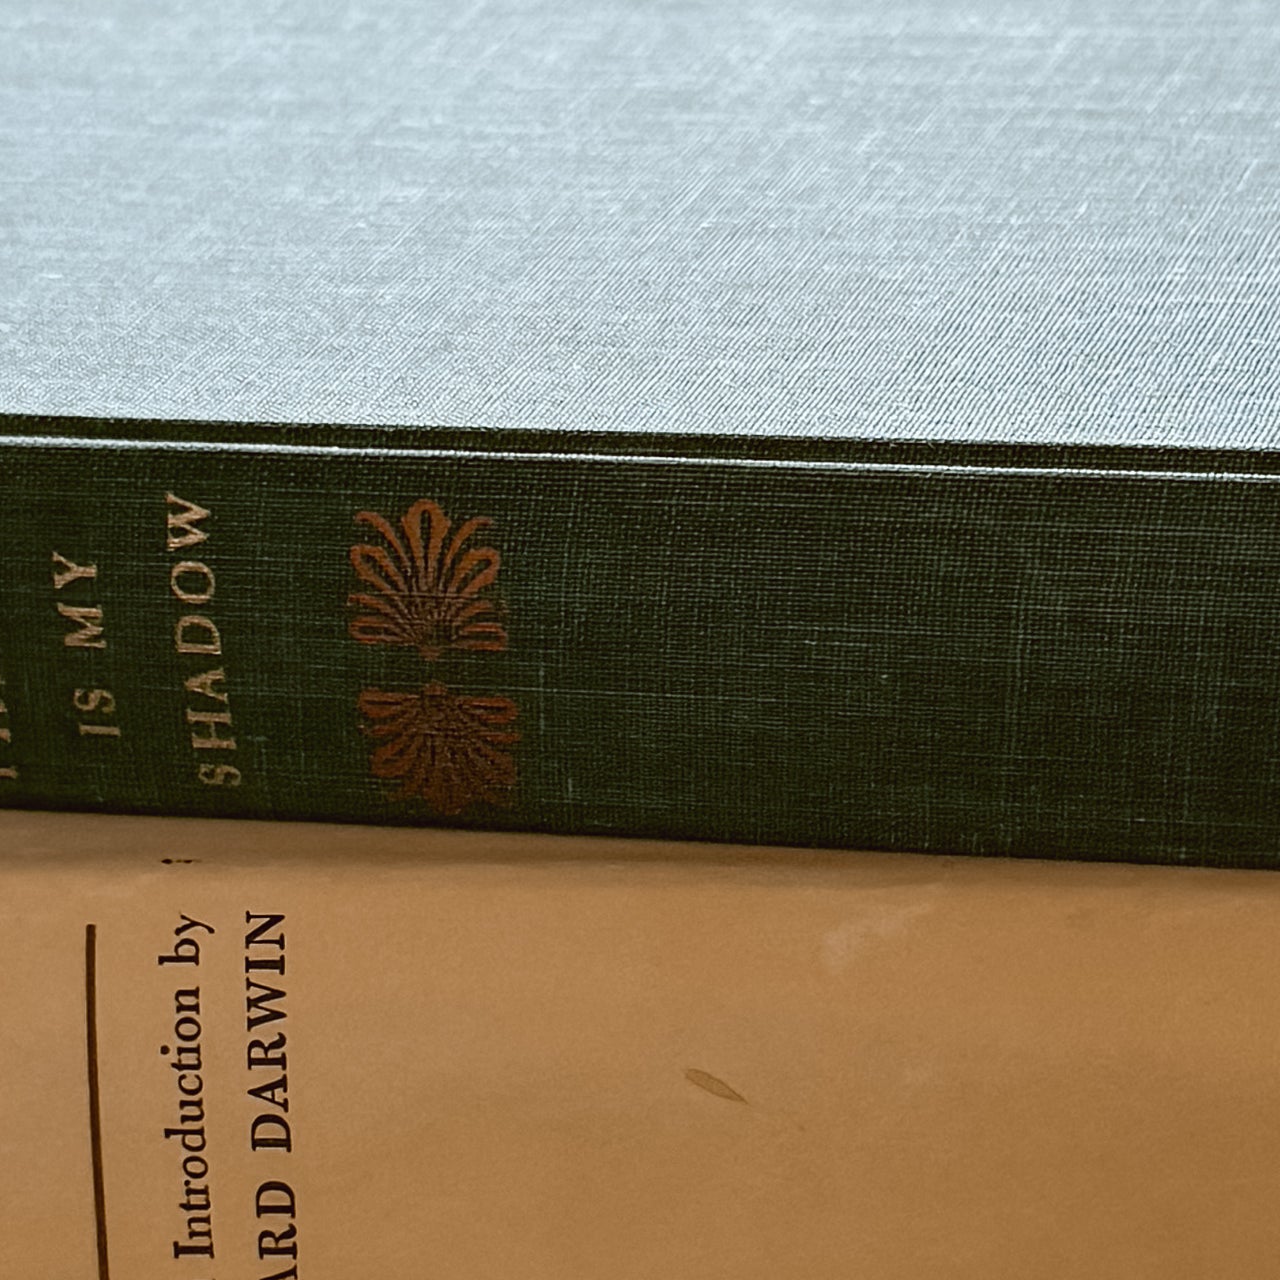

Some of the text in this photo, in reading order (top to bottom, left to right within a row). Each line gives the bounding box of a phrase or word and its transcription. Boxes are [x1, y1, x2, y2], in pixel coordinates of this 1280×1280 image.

[54, 550, 118, 738] IS MY
[167, 491, 241, 787] SHADOW
[158, 913, 215, 968] by
[245, 911, 292, 1153] DARWIN
[161, 984, 217, 1259] Introduction
